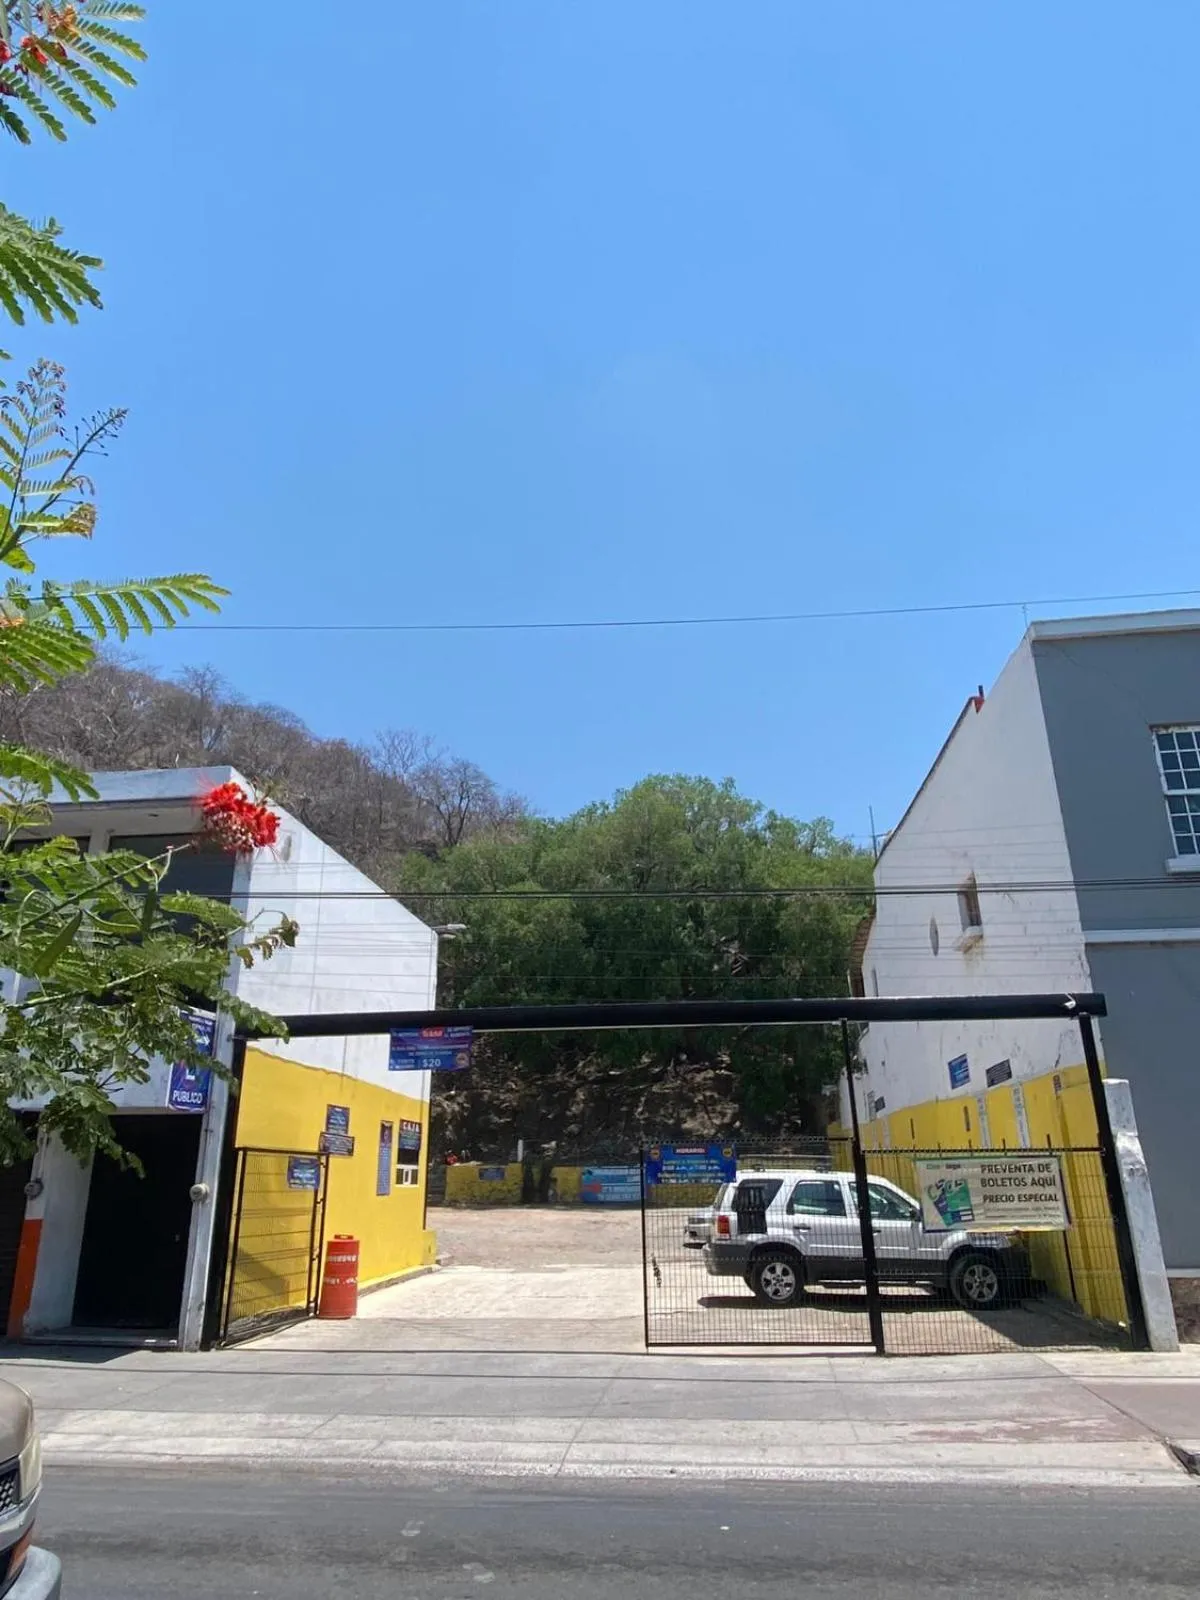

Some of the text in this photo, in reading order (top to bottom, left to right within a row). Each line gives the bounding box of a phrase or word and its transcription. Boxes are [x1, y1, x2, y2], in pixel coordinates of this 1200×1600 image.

[423, 1058, 441, 1068] $20
[403, 1121, 420, 1133] CAJA
[980, 1163, 1053, 1174] PREVENTA DE
[980, 1175, 1057, 1188] BOLETOS AQUÍ
[982, 1192, 1060, 1203] PRECIO ESPECIAL
